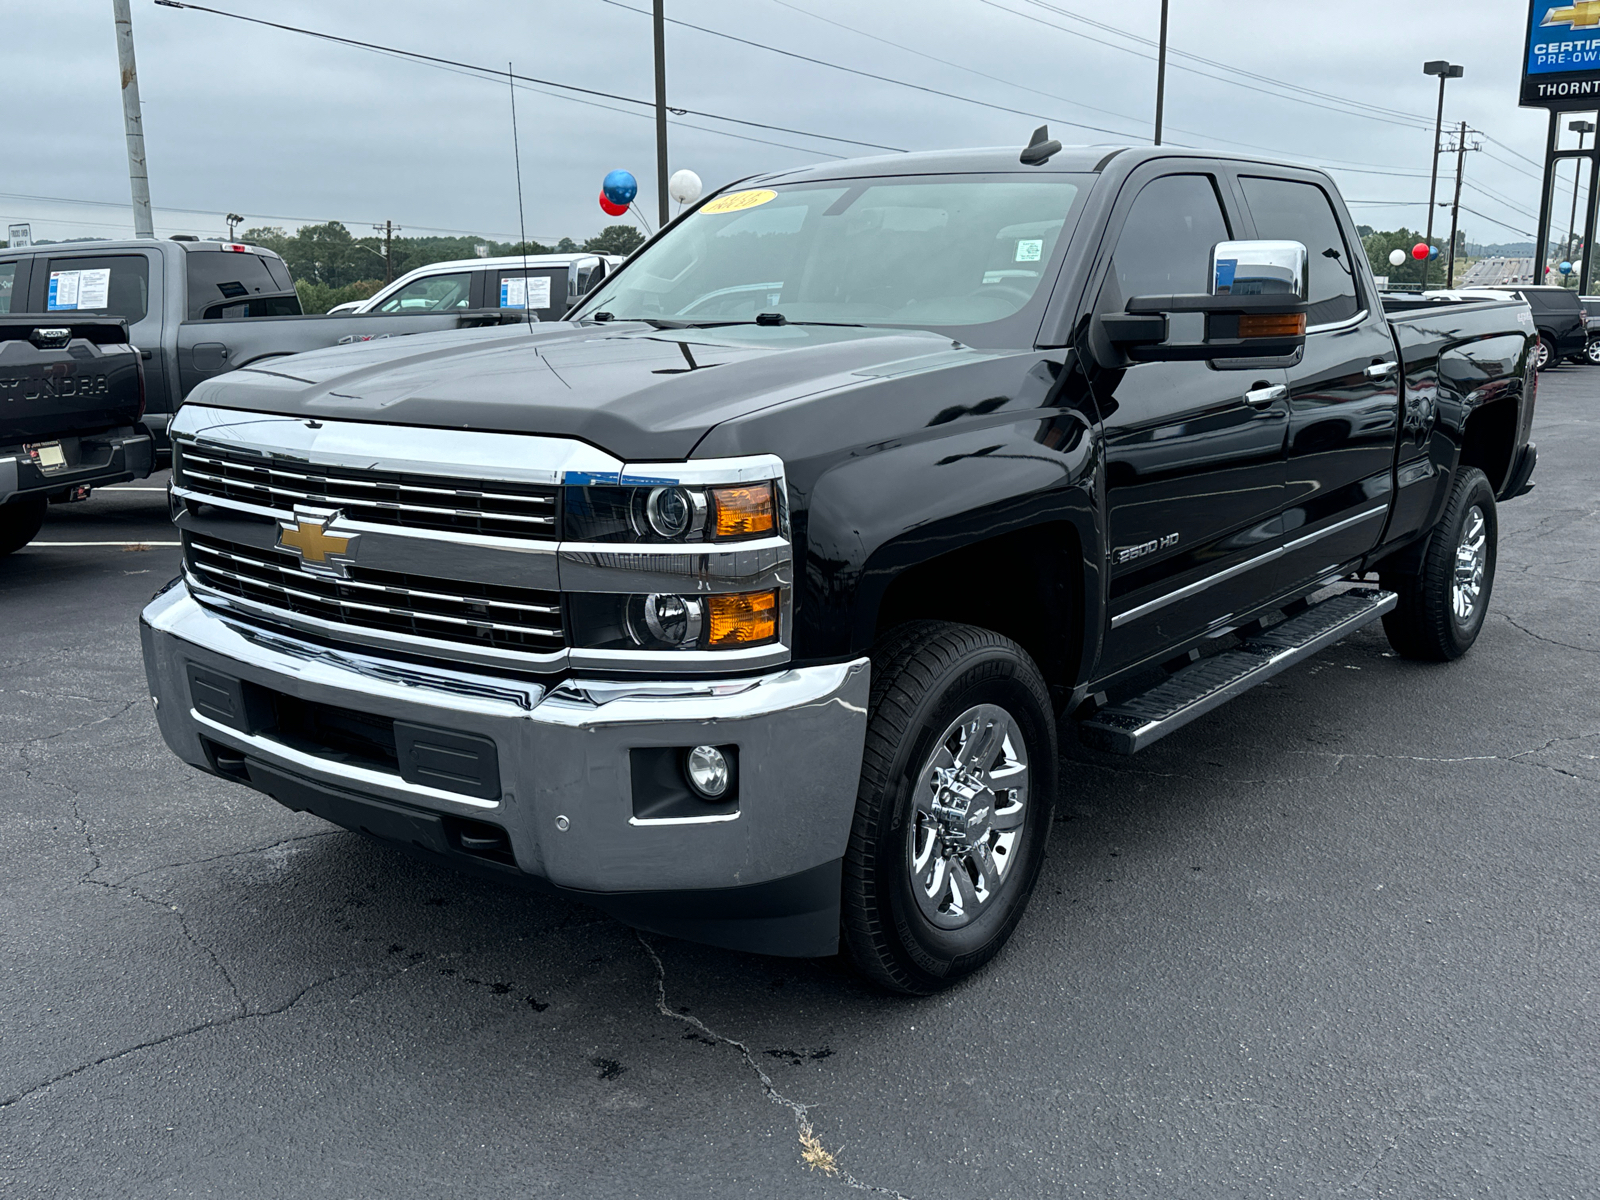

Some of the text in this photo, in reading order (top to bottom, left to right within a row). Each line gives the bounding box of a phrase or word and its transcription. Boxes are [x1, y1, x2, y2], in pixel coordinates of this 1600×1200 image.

[1534, 39, 1600, 54] CERTIF
[1537, 51, 1600, 65] PRE-OW
[1537, 80, 1600, 97] THORNT
[0, 375, 109, 401] TUNDRA
[1118, 532, 1180, 563] 2500 HD
